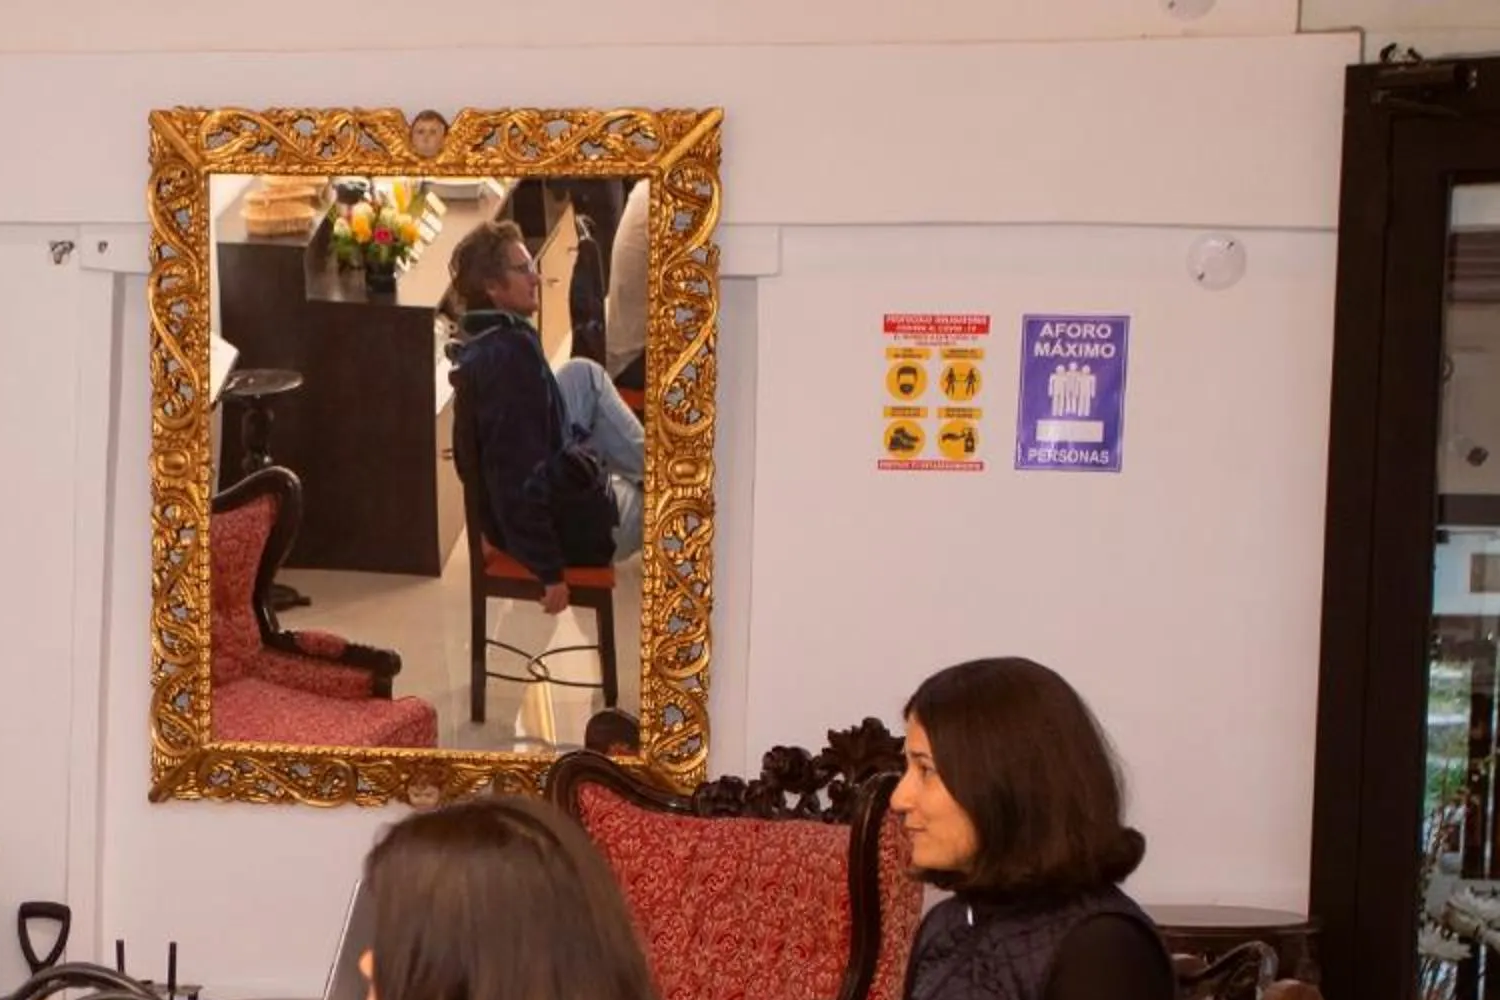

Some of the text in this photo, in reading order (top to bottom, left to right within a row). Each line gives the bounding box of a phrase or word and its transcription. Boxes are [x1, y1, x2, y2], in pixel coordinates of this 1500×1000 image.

[1039, 323, 1112, 339] AFORO
[1034, 339, 1116, 358] MÁXIMO
[1028, 447, 1110, 464] PERSONAS
